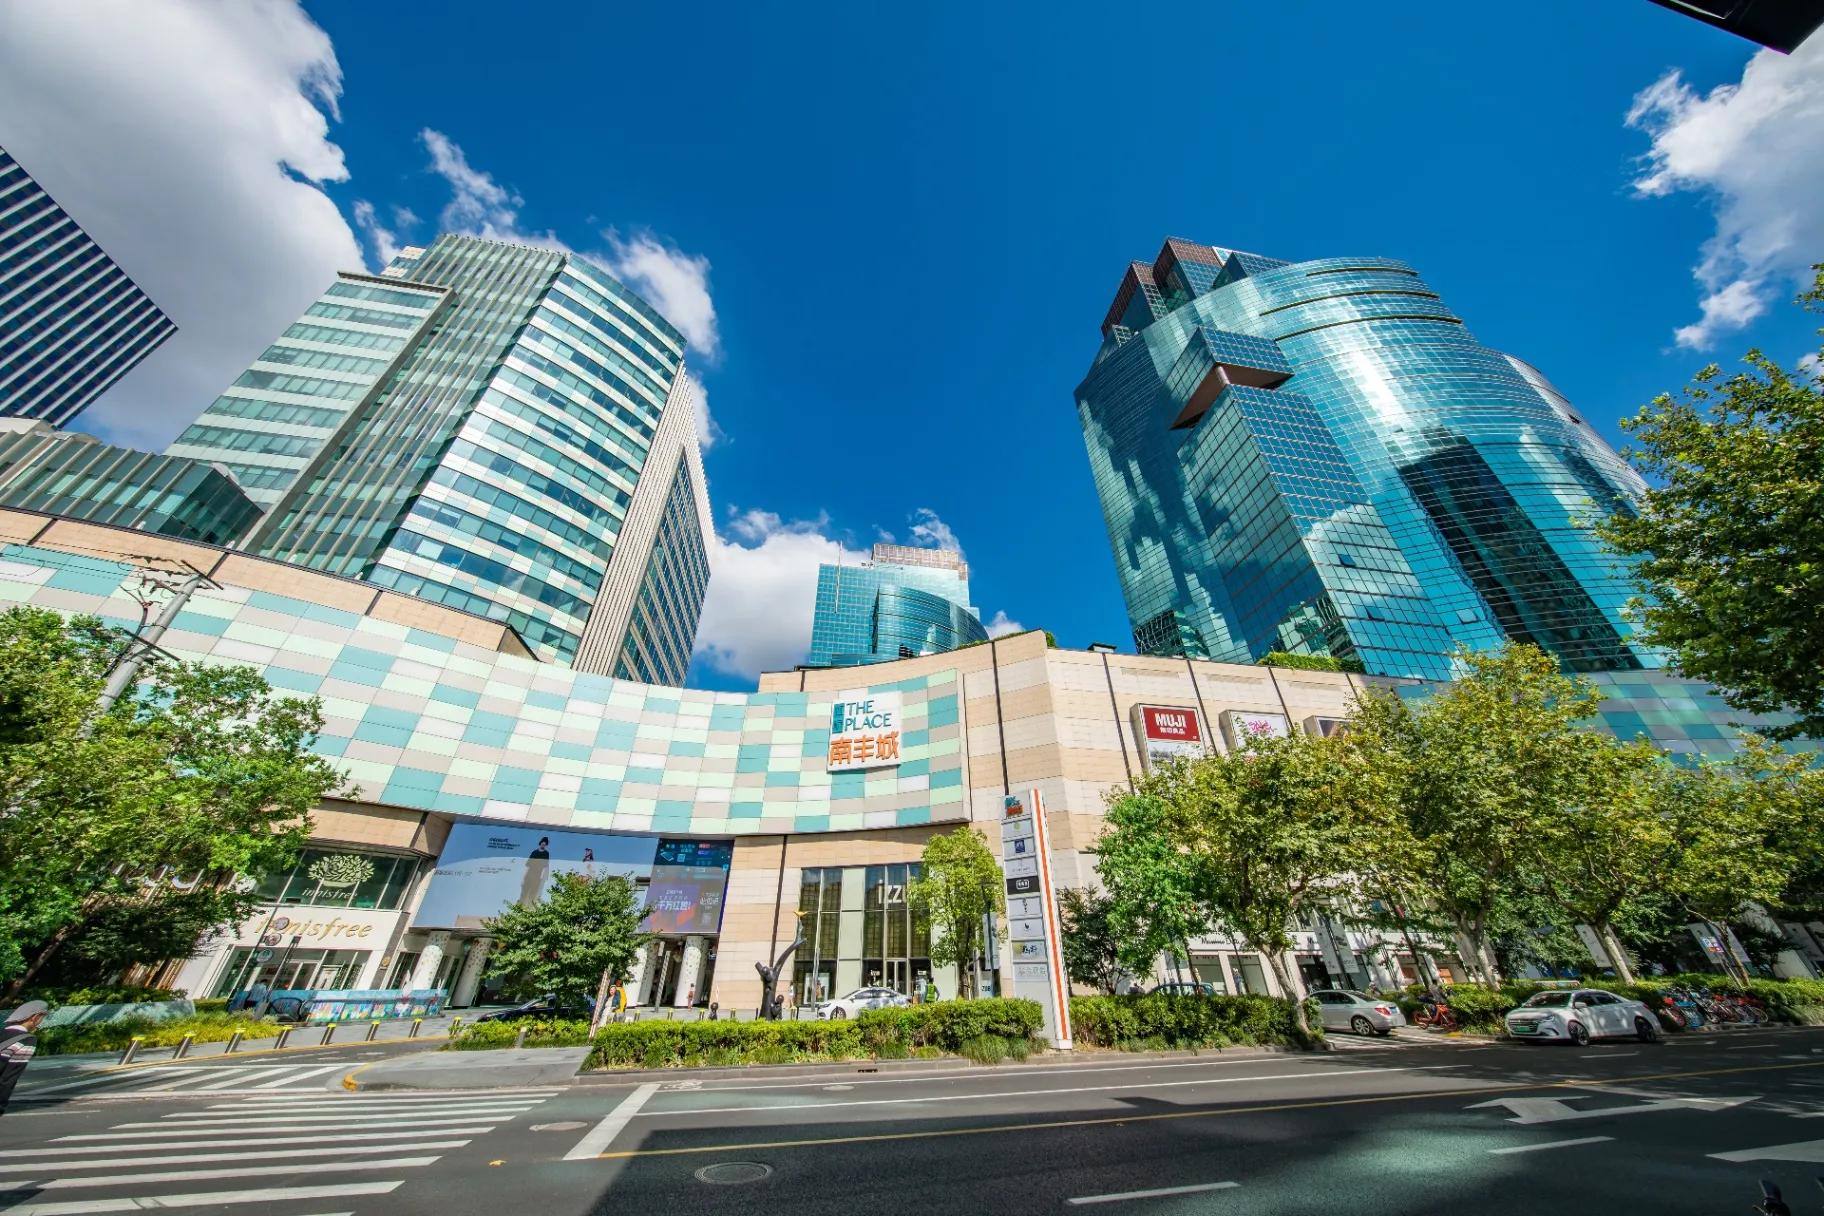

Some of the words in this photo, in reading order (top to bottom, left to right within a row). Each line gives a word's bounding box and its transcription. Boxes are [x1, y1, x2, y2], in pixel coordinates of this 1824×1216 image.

[847, 700, 874, 716] THE
[845, 713, 892, 732] PLACE
[1154, 713, 1187, 728] MUJI
[829, 730, 899, 766] 南丰城
